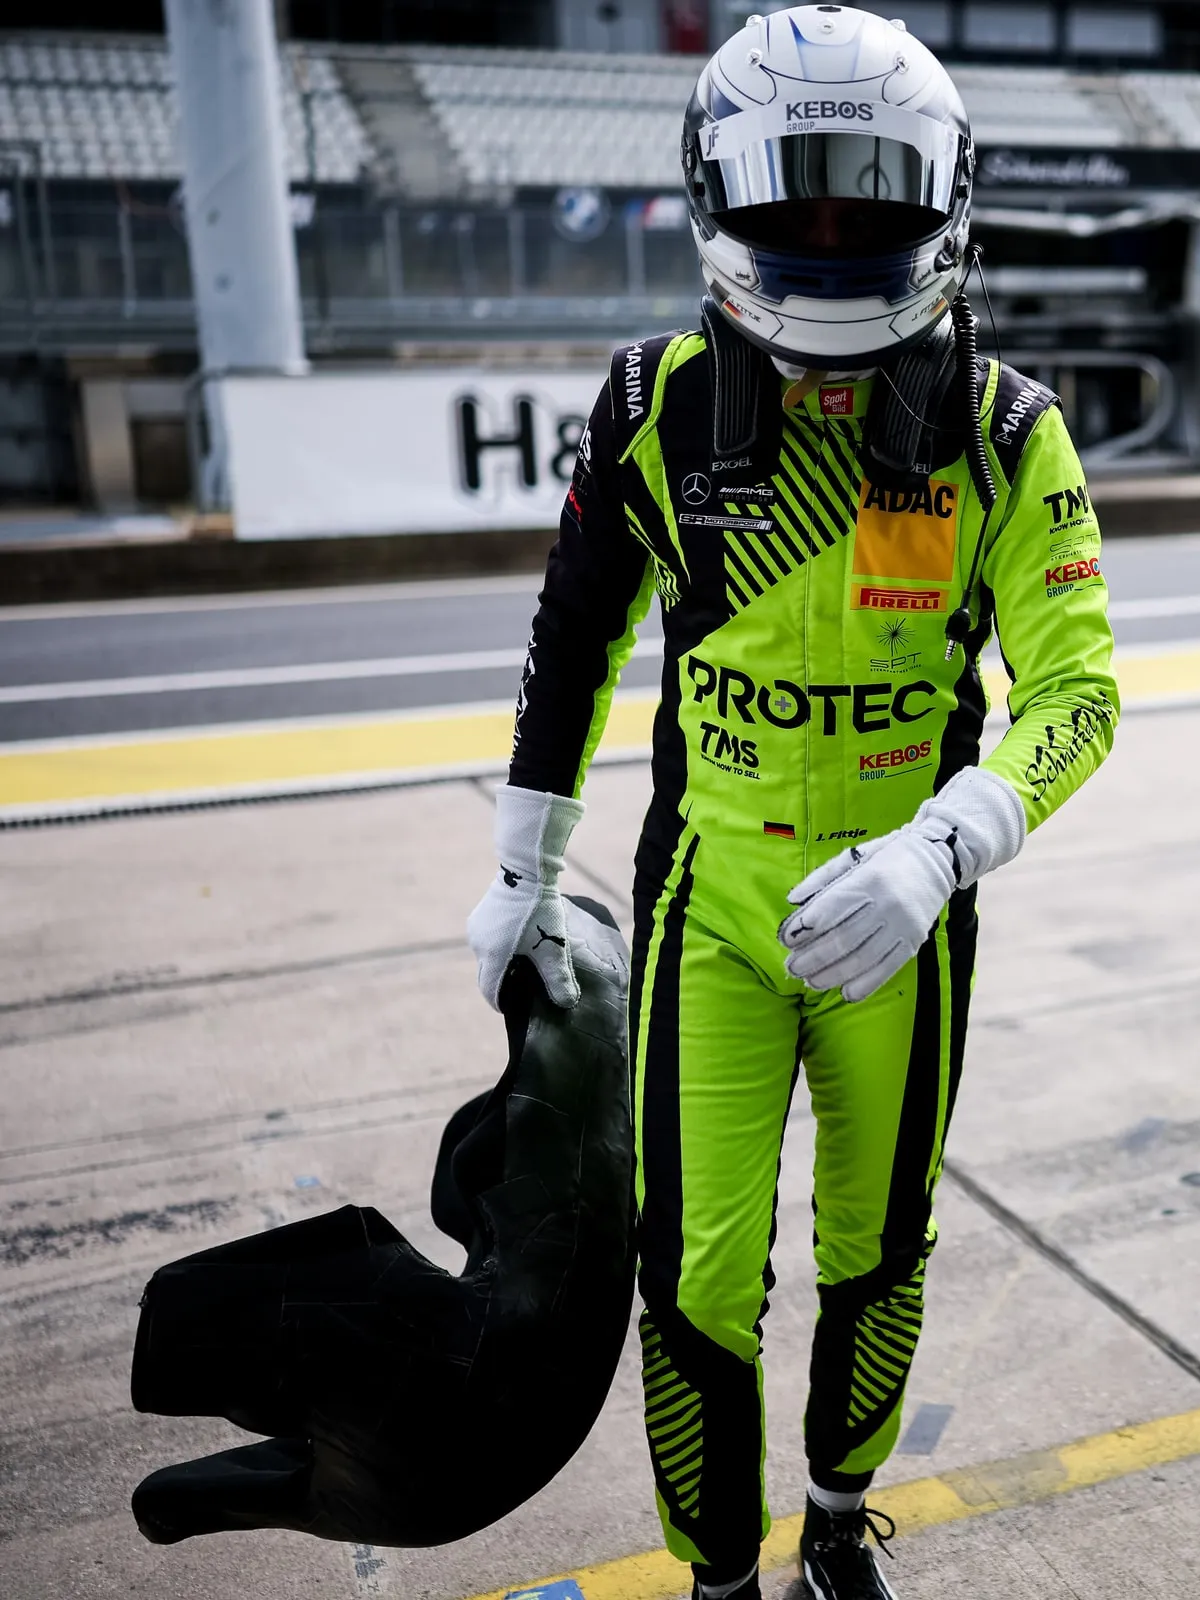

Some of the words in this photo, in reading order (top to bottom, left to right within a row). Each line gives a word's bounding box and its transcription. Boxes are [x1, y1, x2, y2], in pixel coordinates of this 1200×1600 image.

[786, 101, 873, 121] KEBOS
[787, 121, 815, 133] GROUP
[625, 340, 645, 420] MARINA
[823, 390, 847, 406] Sport
[832, 404, 846, 413] Bild
[995, 382, 1042, 445] MARINA
[712, 457, 753, 472] EXGEL
[863, 485, 955, 519] ADAC
[1043, 485, 1088, 524] TM
[705, 517, 761, 528] MOTORSPORT
[860, 588, 940, 609] PIRELLI
[1047, 583, 1075, 598] GROUP
[870, 652, 922, 669] SPT
[687, 654, 938, 736] PROTEC
[700, 721, 759, 769] TMS
[860, 740, 932, 770] KEBOS
[733, 767, 743, 775] TO
[744, 770, 760, 780] SELL
[860, 769, 885, 781] GROUP
[816, 833, 825, 841] J.
[828, 828, 868, 840] Fittje
